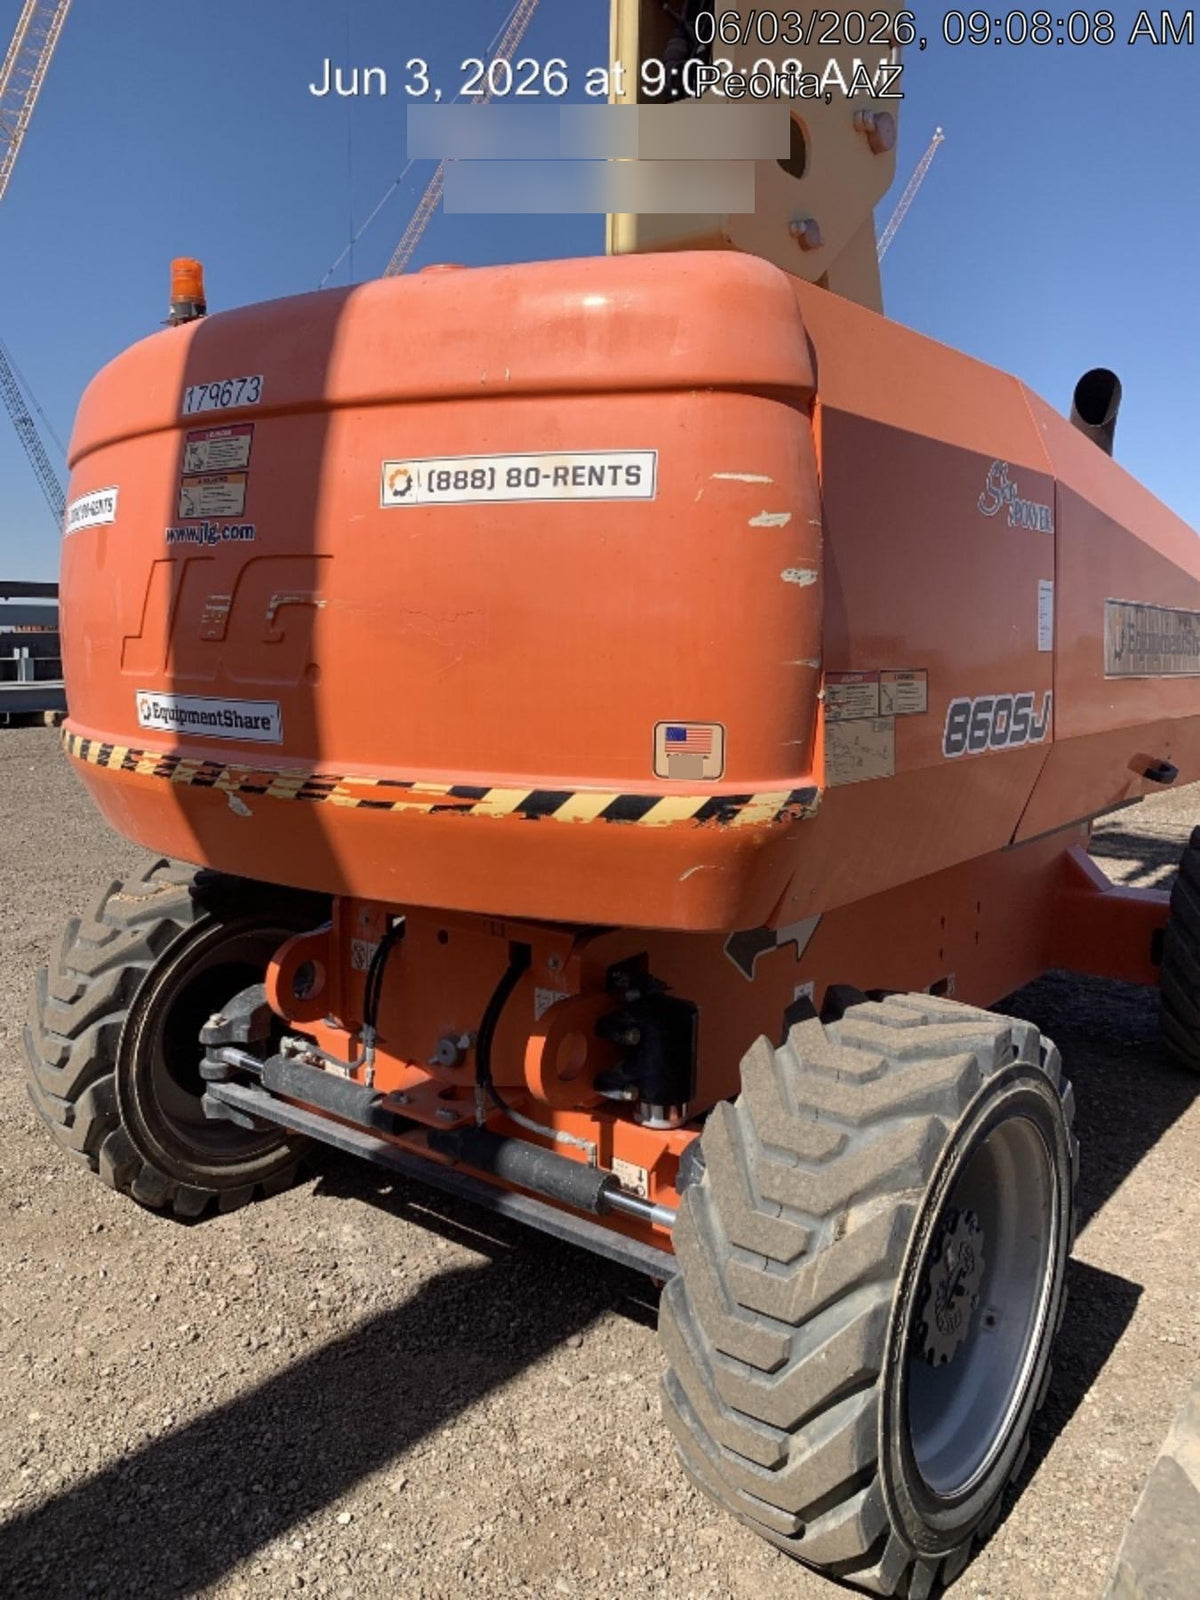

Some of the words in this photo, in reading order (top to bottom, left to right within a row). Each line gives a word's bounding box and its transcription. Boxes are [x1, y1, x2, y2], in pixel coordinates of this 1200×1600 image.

[187, 376, 261, 413] 179673
[427, 467, 496, 493] (888)
[506, 464, 643, 488] 80-RENTS
[165, 520, 255, 546] www.jlg.com
[151, 701, 272, 731] EquipmentShare
[942, 690, 1054, 758] 860SJ
